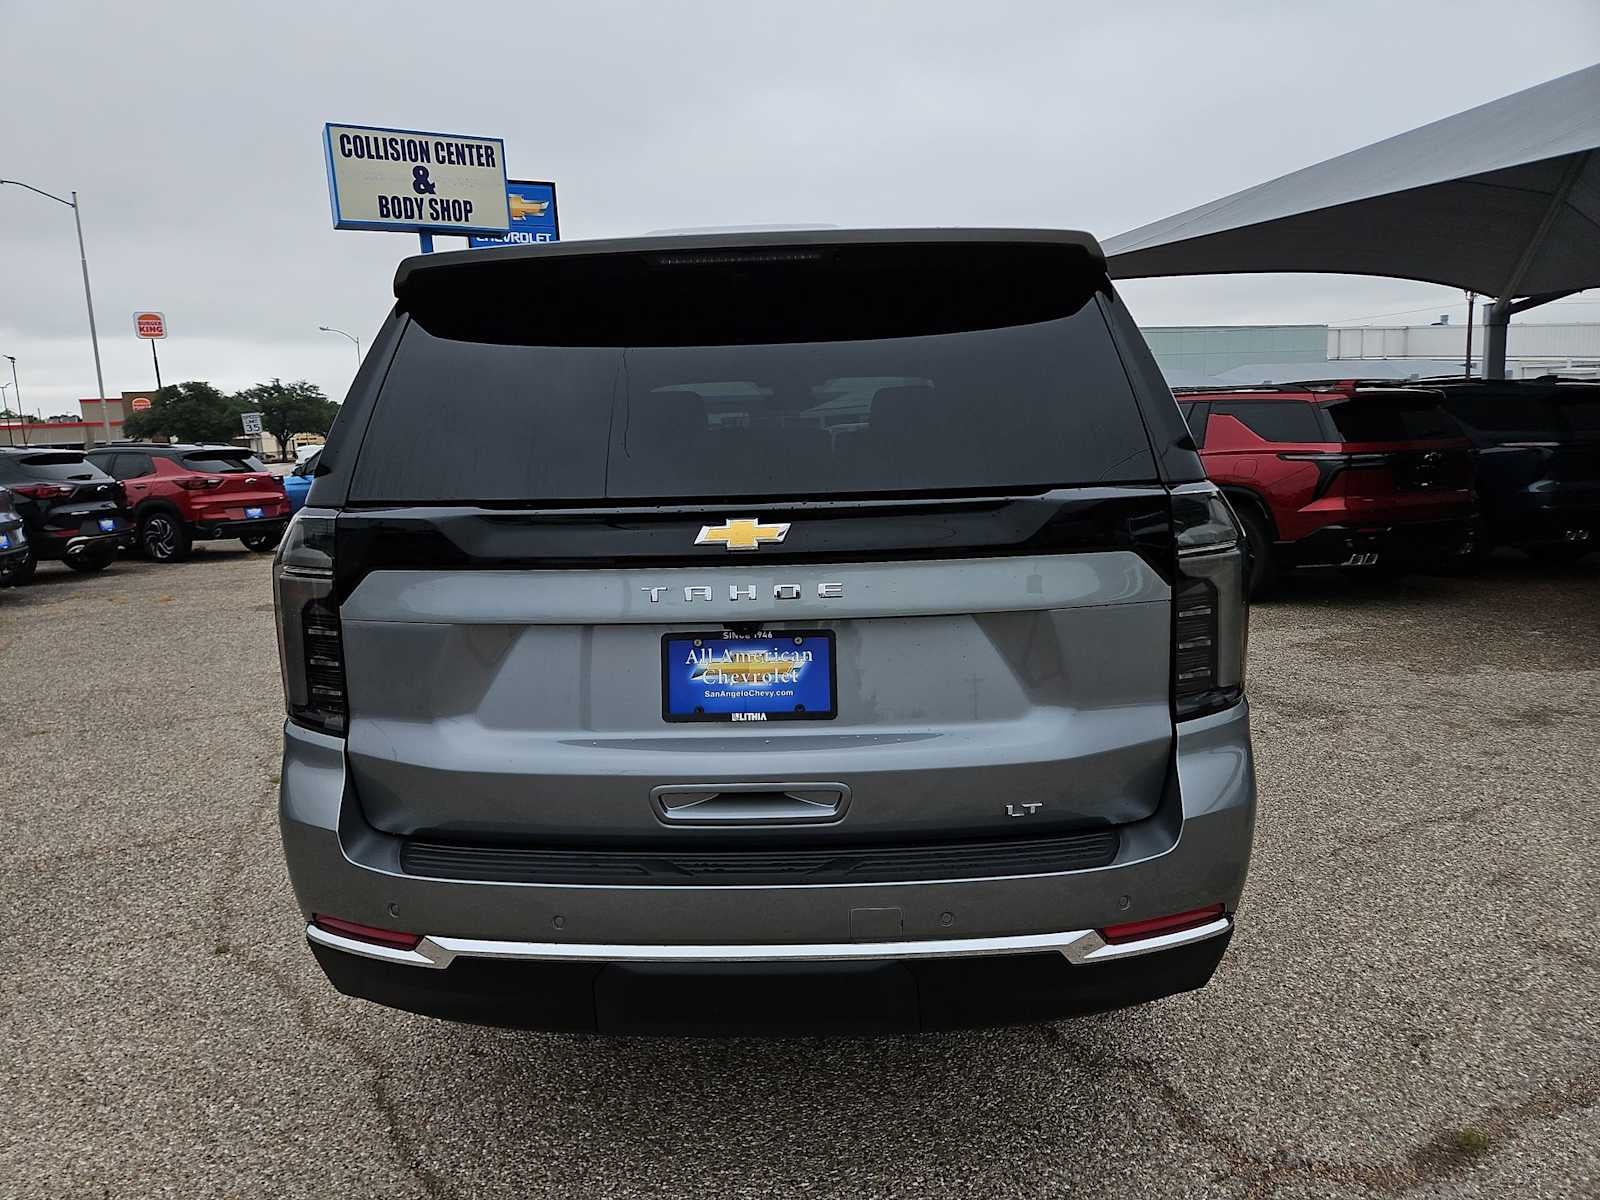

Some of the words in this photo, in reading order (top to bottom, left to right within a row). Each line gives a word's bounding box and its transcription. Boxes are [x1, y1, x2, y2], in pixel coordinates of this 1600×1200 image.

[339, 133, 431, 163] COLLISION
[434, 141, 496, 168] CENTER
[412, 165, 436, 195] &
[378, 195, 424, 220] BODY
[428, 198, 473, 223] SHOP
[641, 583, 844, 602] TAHOE
[685, 648, 713, 664] All
[720, 647, 813, 664] American
[702, 668, 799, 685] Chevrolet
[704, 689, 794, 698] SanAngeloChevy.com
[1005, 802, 1043, 817] LT
